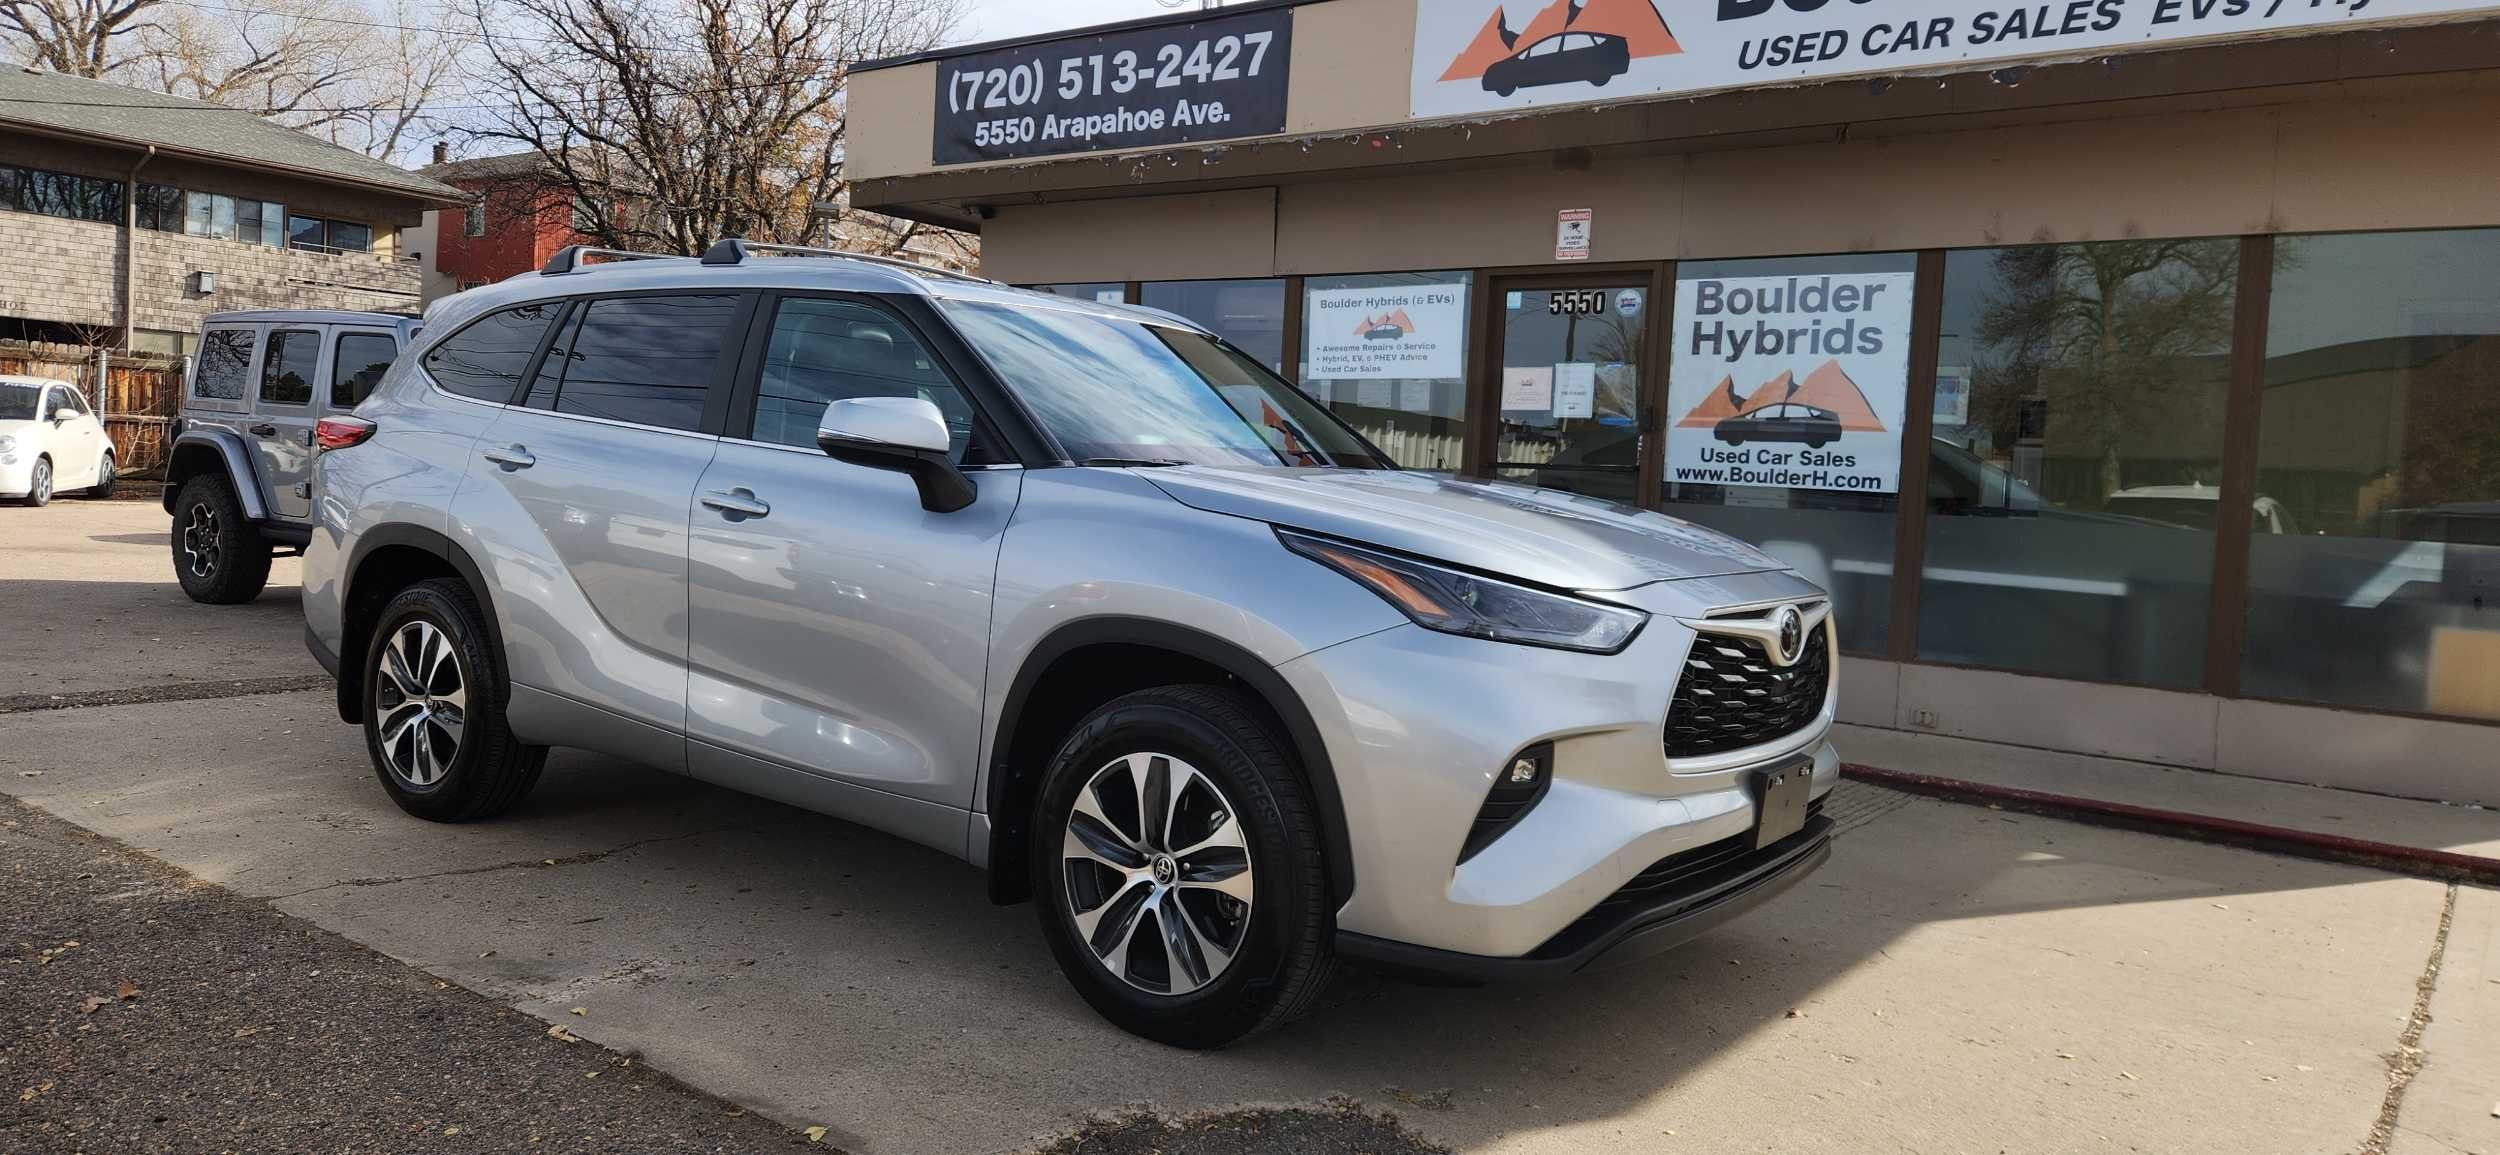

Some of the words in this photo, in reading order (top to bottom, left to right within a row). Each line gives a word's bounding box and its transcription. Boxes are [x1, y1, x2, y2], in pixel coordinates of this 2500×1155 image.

[1738, 29, 1848, 70] USED
[1861, 17, 1955, 56] CAR
[1967, 0, 2125, 45] SALES
[949, 58, 1043, 114] (720)
[1058, 31, 1273, 99] 513-2427
[975, 117, 1034, 147] 5550
[1041, 106, 1165, 141] Arapahoe
[1172, 99, 1231, 127] Ave.
[1320, 297, 1362, 309] Boulder
[1366, 295, 1409, 308] Hybrids
[1427, 294, 1455, 305] EVs)
[1549, 290, 1606, 315] 5550
[1695, 277, 1887, 315] Boulder
[1322, 344, 1361, 352] Awesome
[1362, 343, 1394, 353] Repairs
[1404, 342, 1436, 350] Service
[1691, 319, 1884, 363] Hybrids
[1321, 365, 1341, 373] Used
[1344, 365, 1357, 373] Car
[1360, 364, 1382, 373] Sales
[1374, 353, 1397, 361] PHEV
[1400, 352, 1428, 361] Advice
[1700, 448, 1750, 464] Used
[1757, 449, 1792, 465] Car
[1800, 451, 1856, 468] Sales
[1676, 467, 1881, 490] www.BoulderH.com
